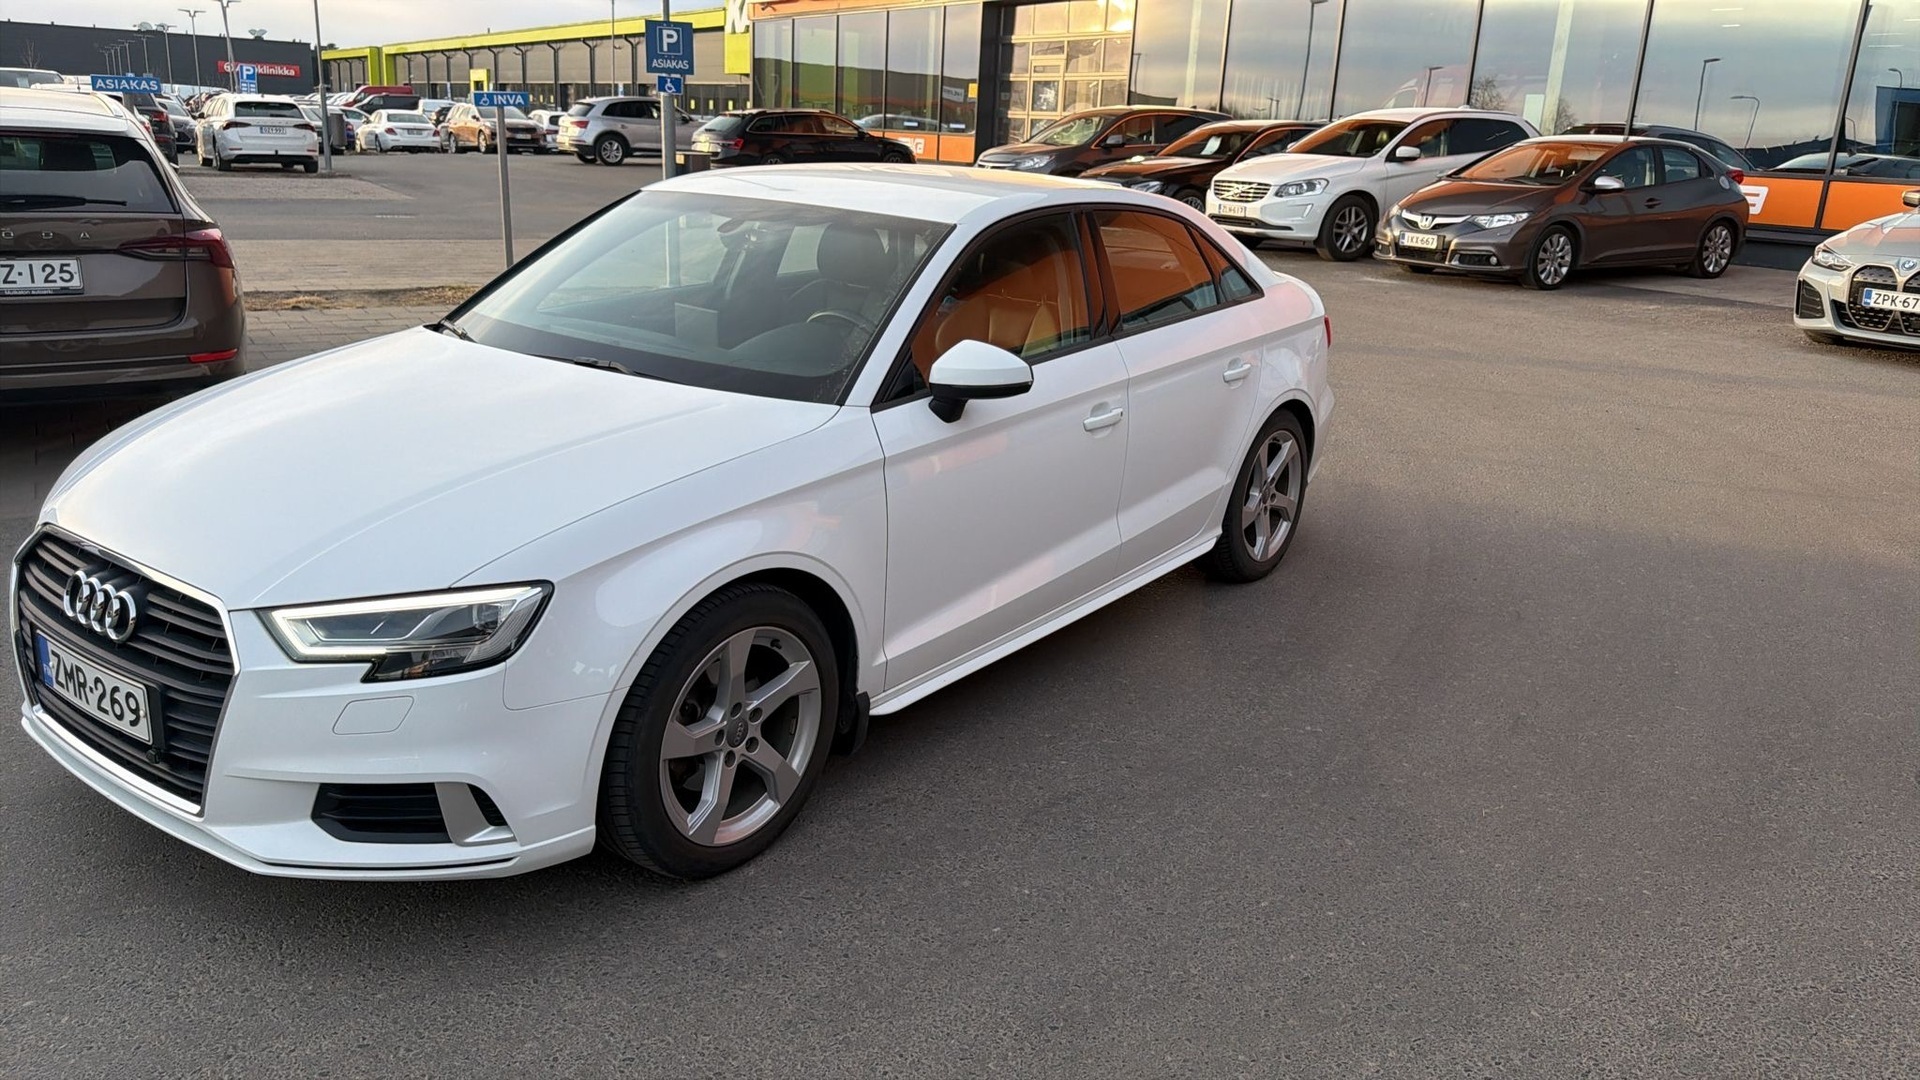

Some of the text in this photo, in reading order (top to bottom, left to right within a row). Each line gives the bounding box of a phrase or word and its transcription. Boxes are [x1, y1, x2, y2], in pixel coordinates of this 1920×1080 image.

[662, 29, 678, 52] P
[652, 58, 689, 69] ASIAKAS
[243, 66, 254, 80] P
[96, 79, 158, 91] ASIAKAS
[493, 94, 525, 105] INVA
[51, 650, 141, 727] ZMR-269
